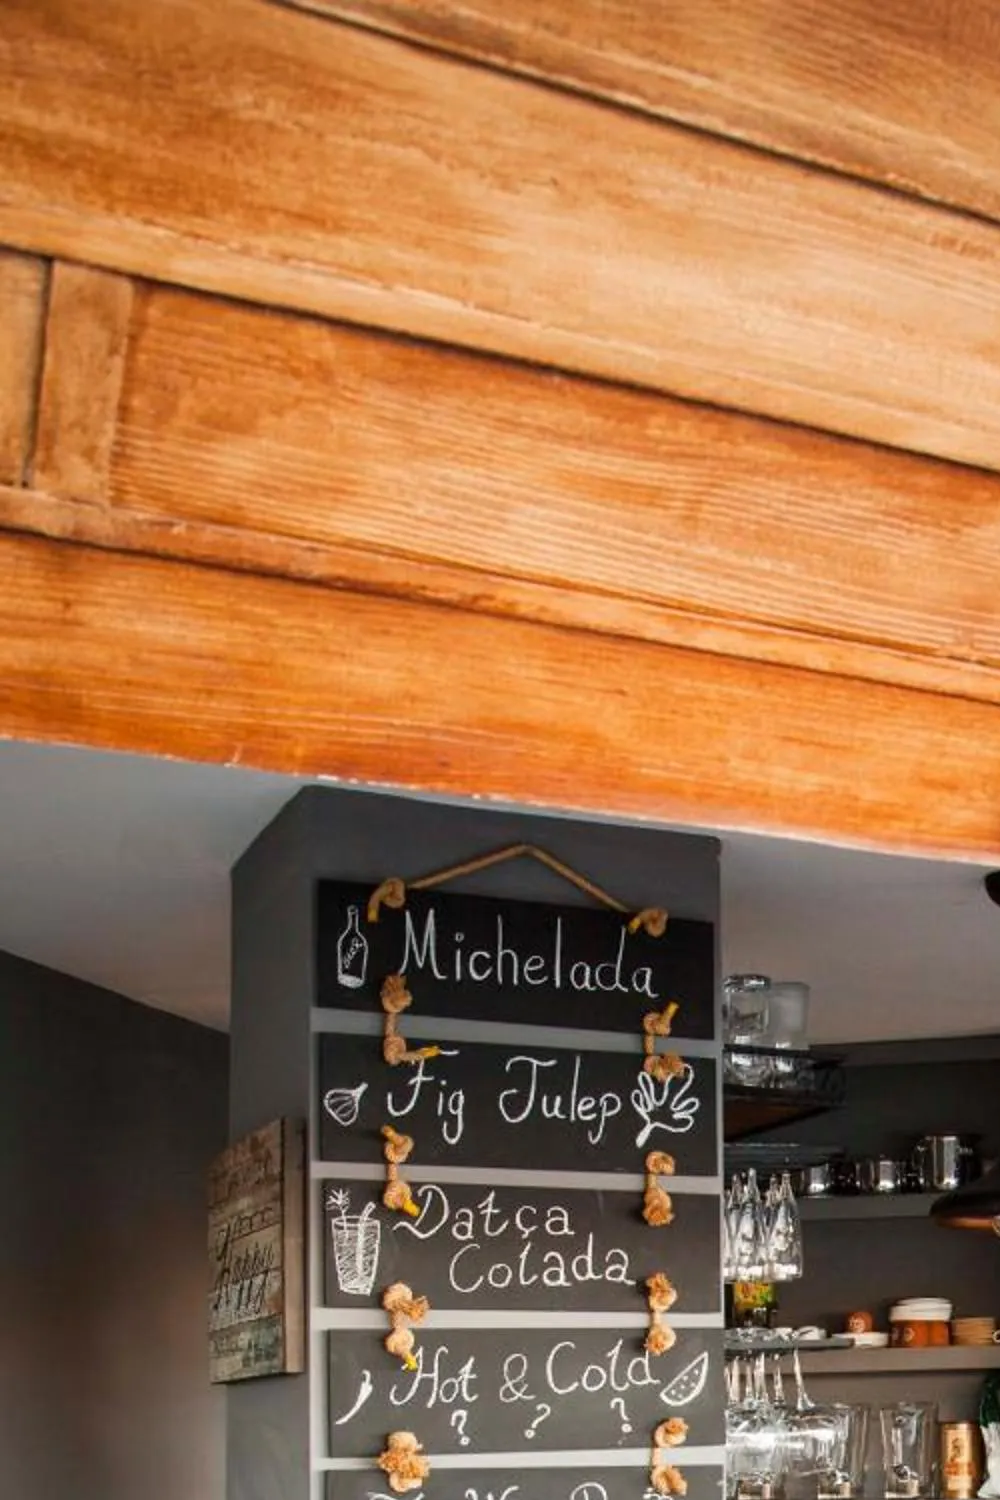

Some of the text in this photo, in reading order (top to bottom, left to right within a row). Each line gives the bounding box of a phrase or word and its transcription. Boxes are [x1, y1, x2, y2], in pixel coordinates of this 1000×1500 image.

[398, 906, 660, 999] Michelada
[386, 1050, 622, 1145] Fig Julep
[393, 1184, 575, 1241] Datça
[449, 1231, 636, 1293] Colada
[389, 1338, 661, 1409] Hot & Cold
